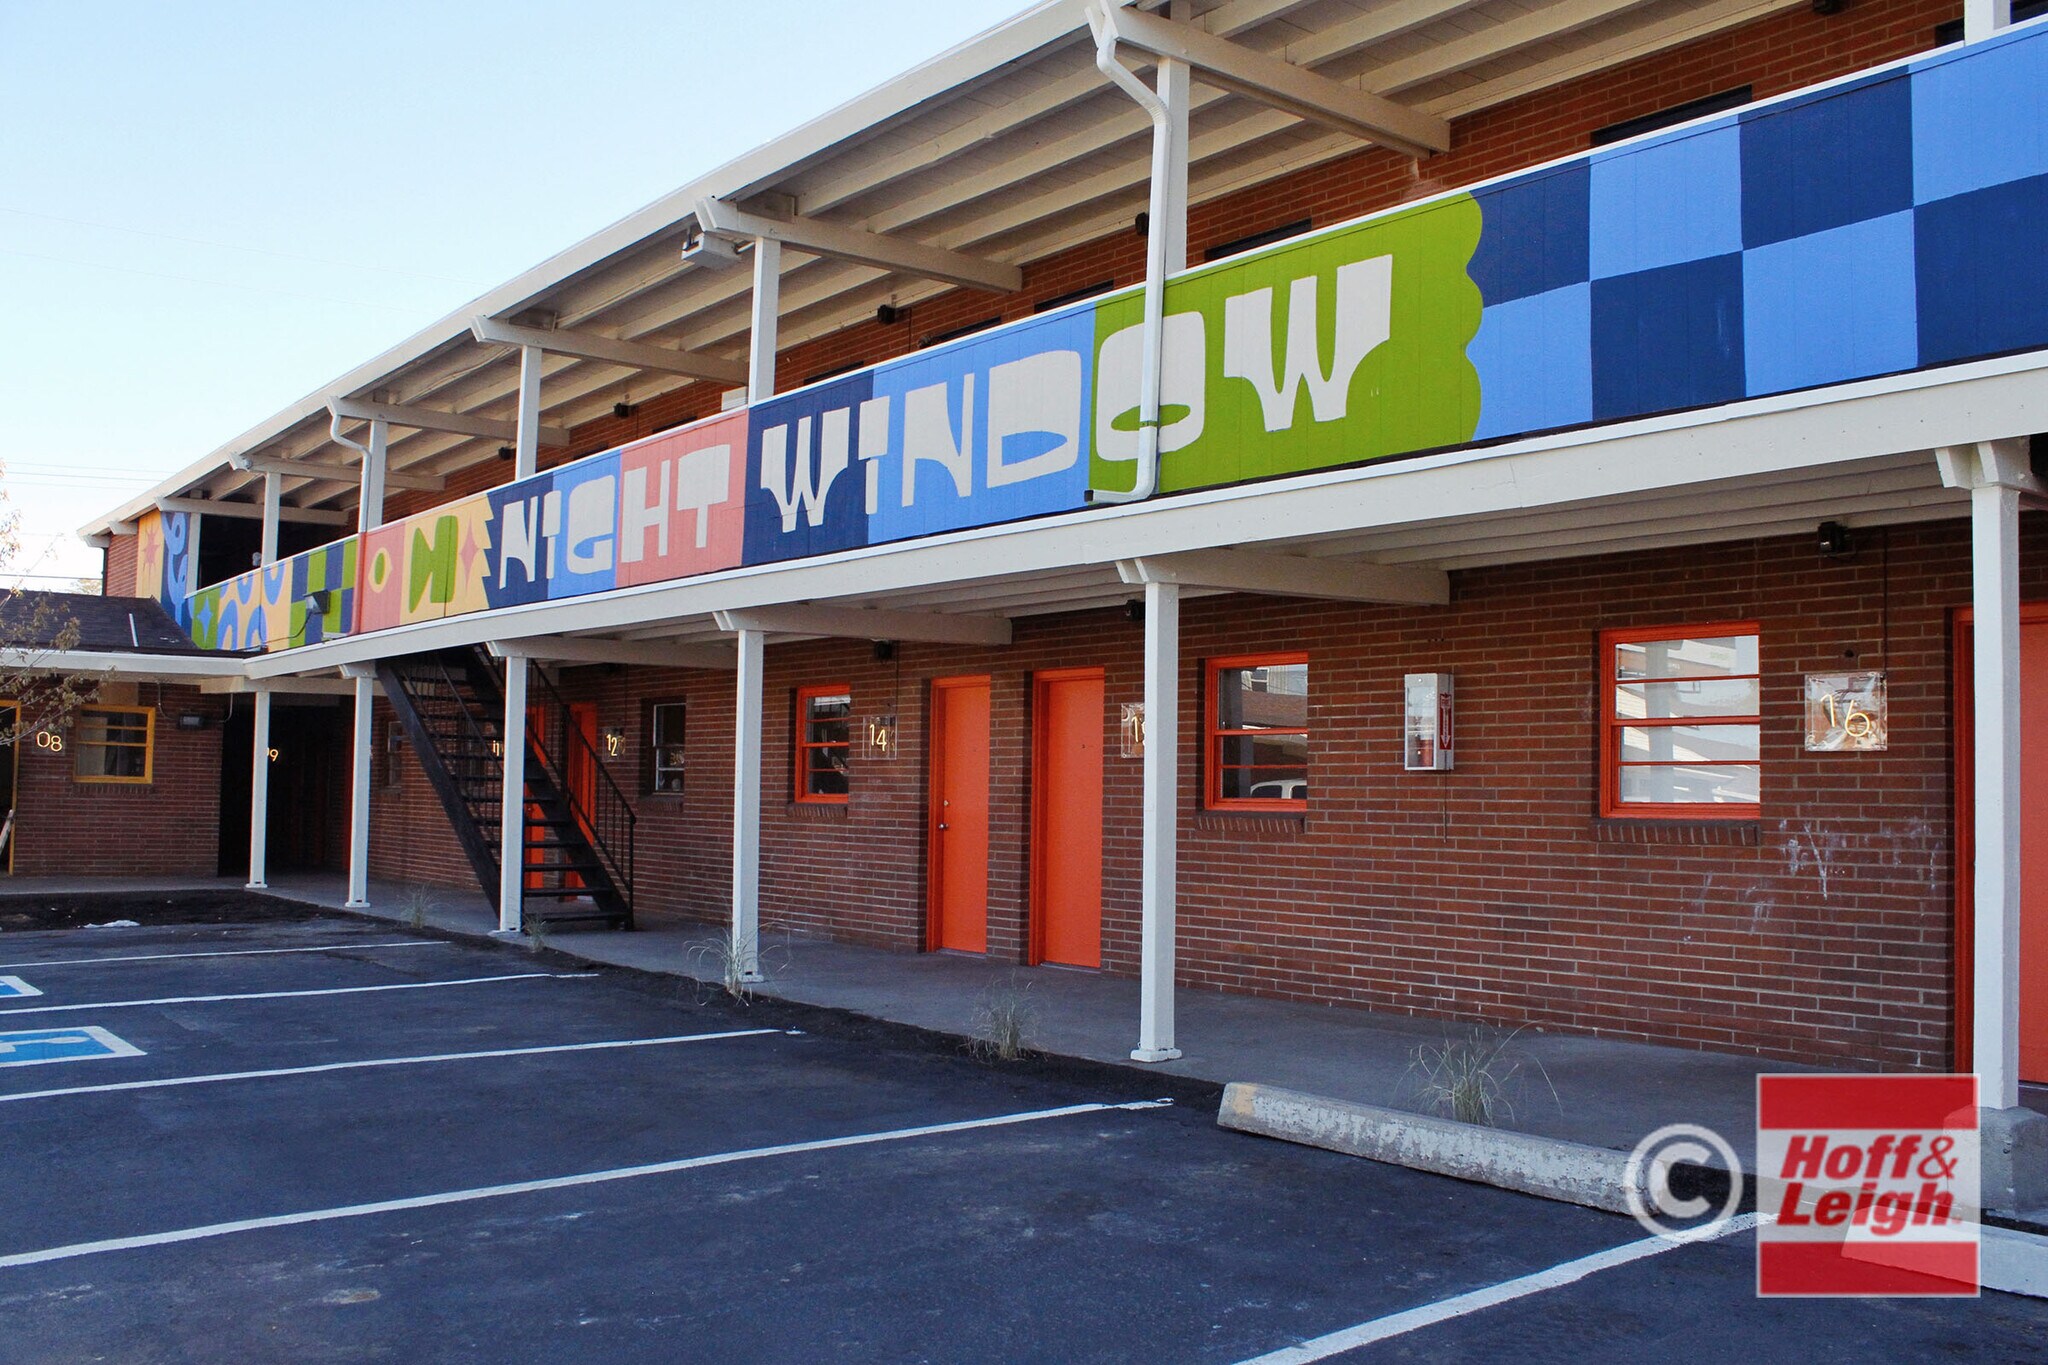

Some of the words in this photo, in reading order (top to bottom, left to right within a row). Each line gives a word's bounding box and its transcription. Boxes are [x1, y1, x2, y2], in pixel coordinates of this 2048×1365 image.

[498, 441, 731, 590] NIGHT
[760, 254, 1393, 533] WINDOW
[1820, 694, 1870, 737] 16
[36, 731, 63, 752] 08
[606, 734, 617, 756] 12
[869, 723, 888, 752] 14
